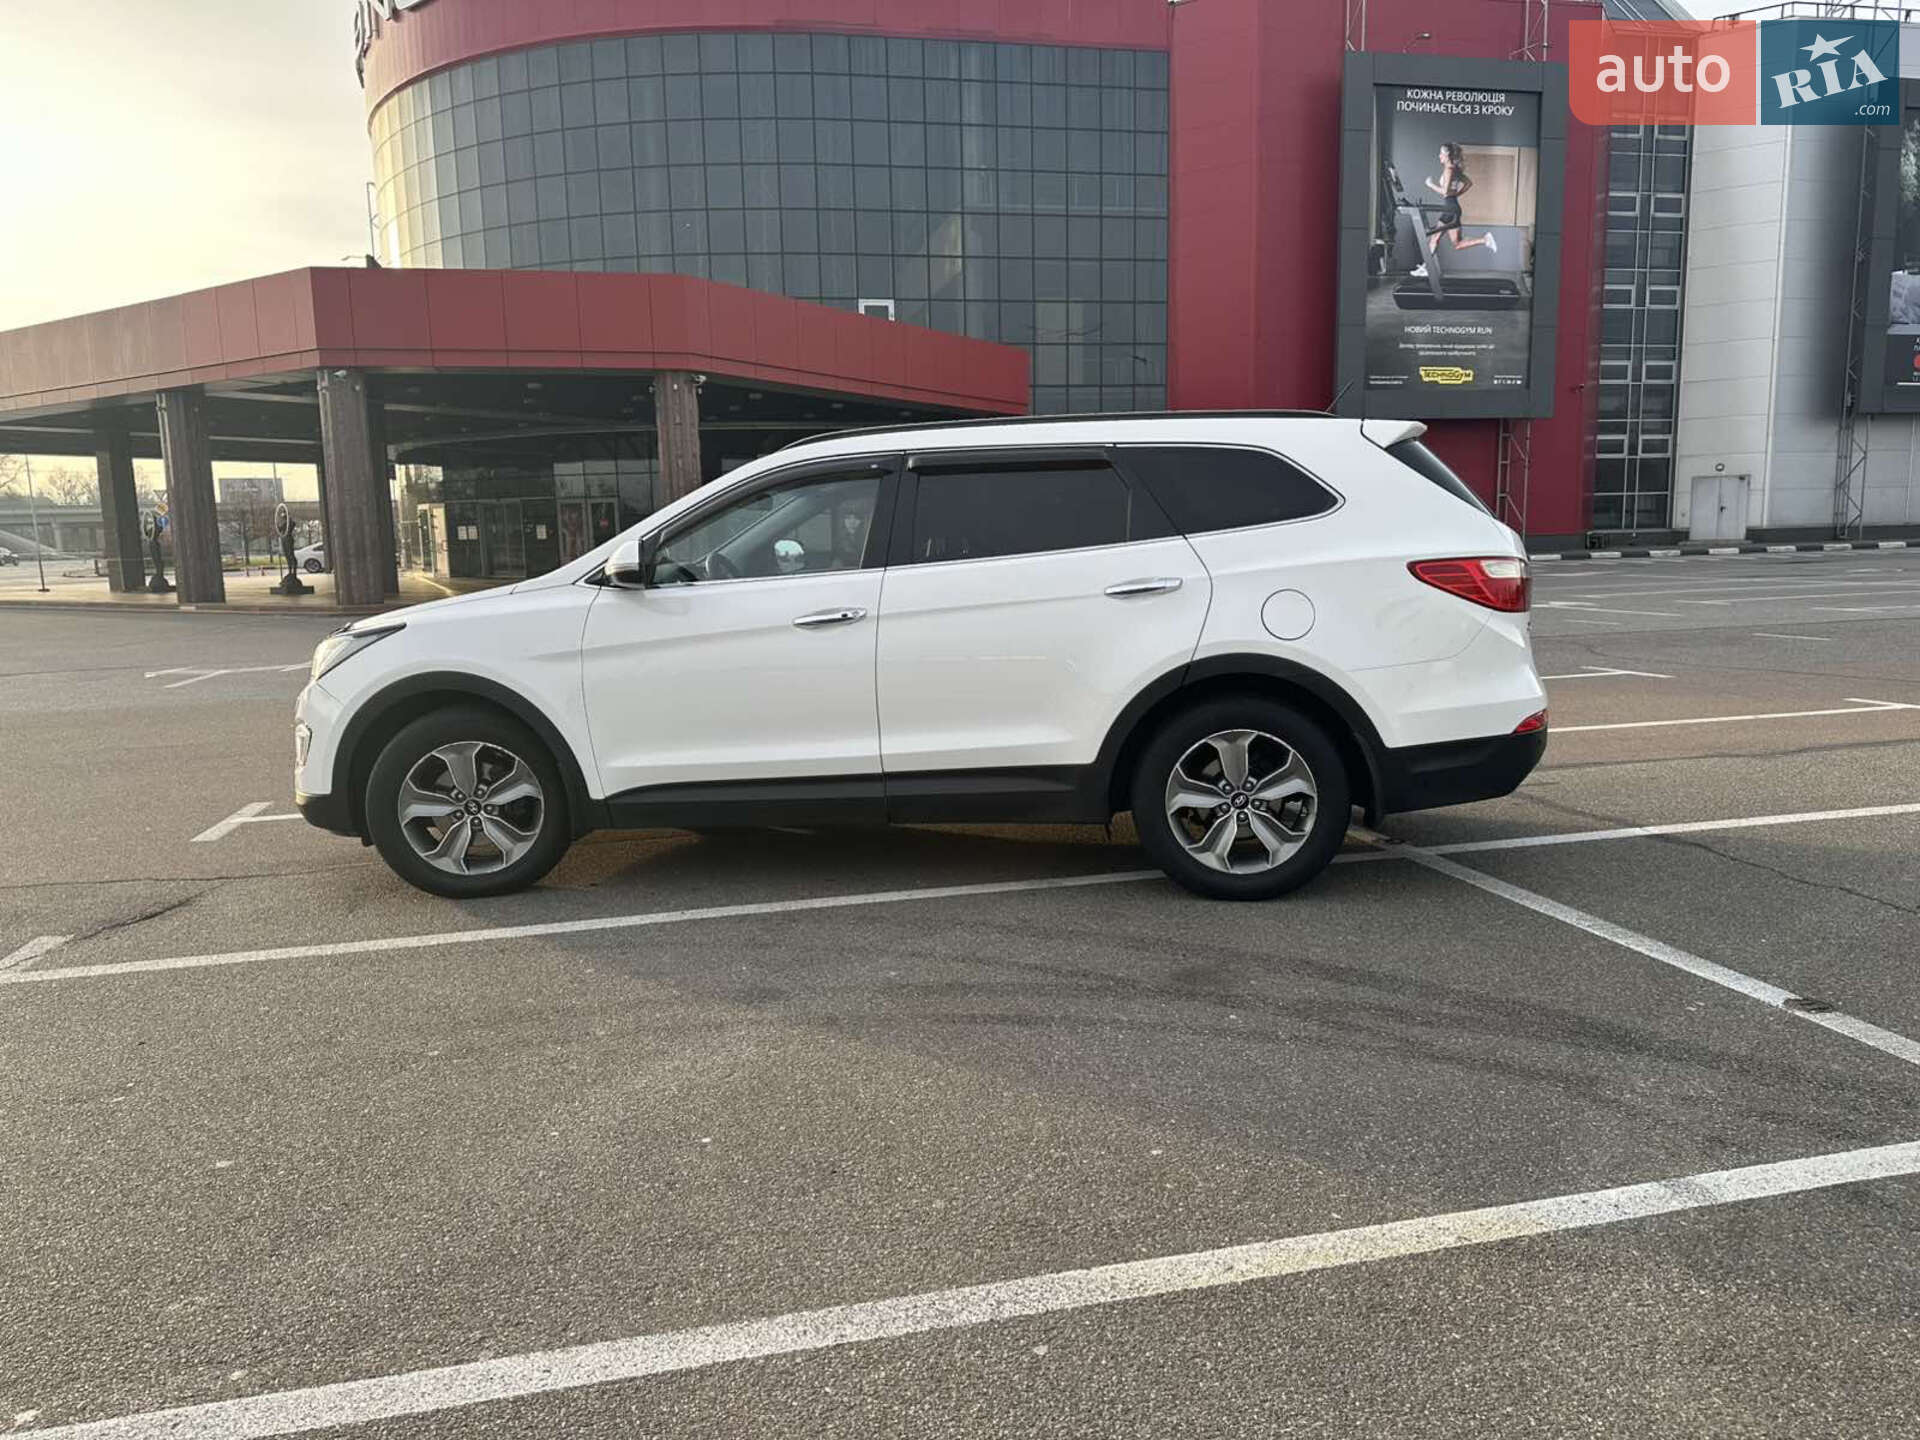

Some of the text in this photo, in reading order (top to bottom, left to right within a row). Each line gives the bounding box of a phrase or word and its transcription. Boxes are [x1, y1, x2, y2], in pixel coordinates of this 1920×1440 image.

[1407, 89, 1505, 104] КОЖНА РЕВОЛЮЦІЯ
[1397, 101, 1471, 114] ПОЧИНАЄТЬСЯ
[1482, 106, 1514, 116] КРОКУ
[1404, 324, 1492, 335] НОВИЙ TECHNOGYM RUN
